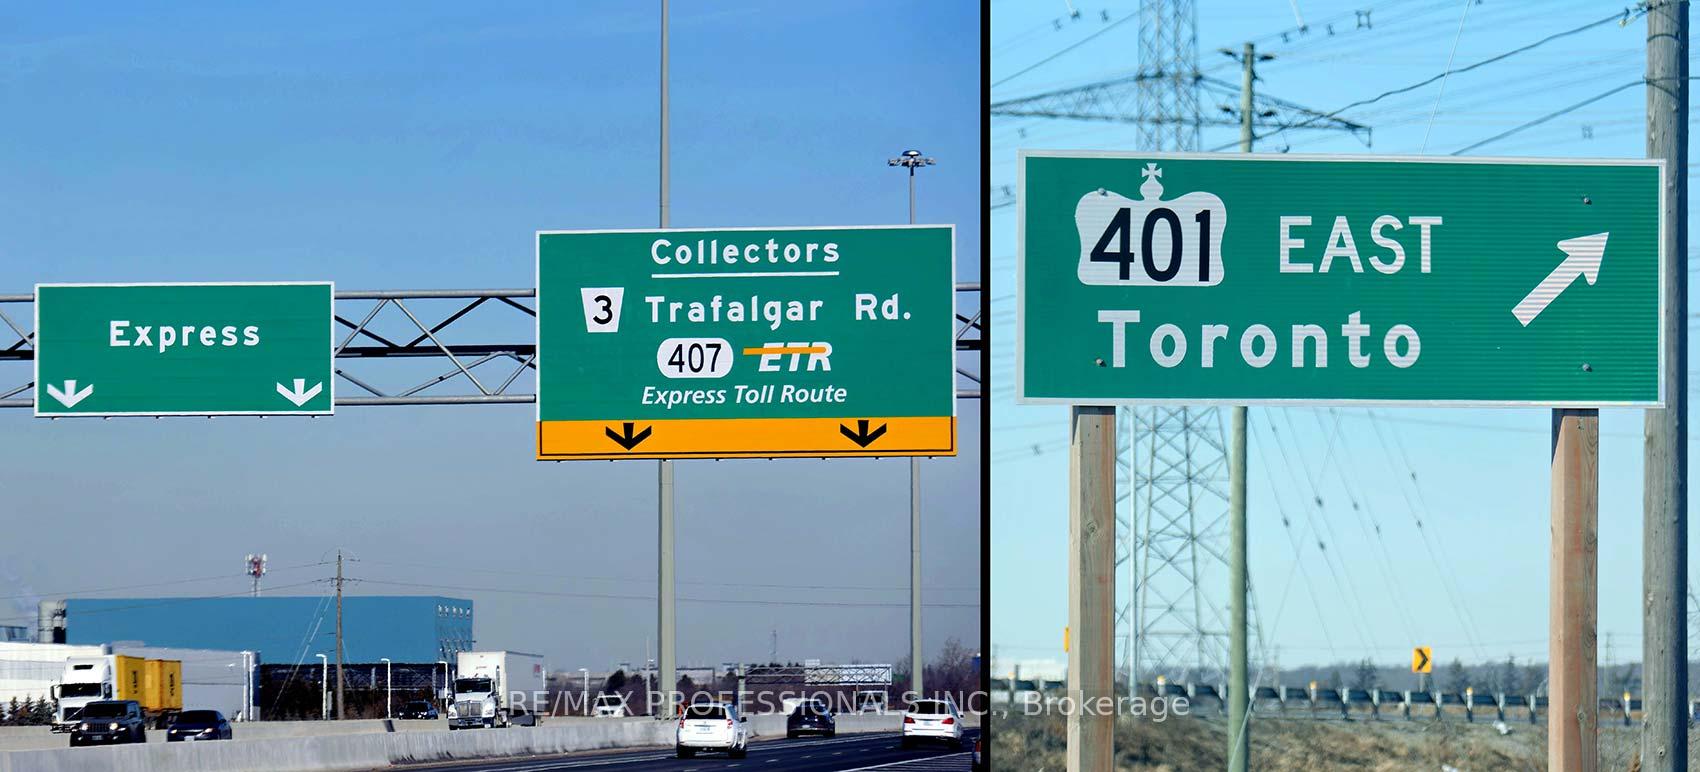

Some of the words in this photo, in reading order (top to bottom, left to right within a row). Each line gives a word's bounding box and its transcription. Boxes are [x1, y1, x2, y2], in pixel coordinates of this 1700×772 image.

[650, 239, 841, 265] Collectors
[1089, 206, 1211, 283] 401
[1279, 214, 1443, 274] EAST
[592, 294, 614, 325] 3
[645, 295, 824, 330] Trafalgar
[855, 293, 911, 320] Rd.
[109, 320, 261, 353] Express
[1097, 310, 1422, 369] Toronto
[668, 343, 722, 373] 407
[758, 342, 833, 372] ETR
[642, 386, 727, 409] Express
[734, 385, 773, 404] Toll
[780, 385, 847, 403] Route
